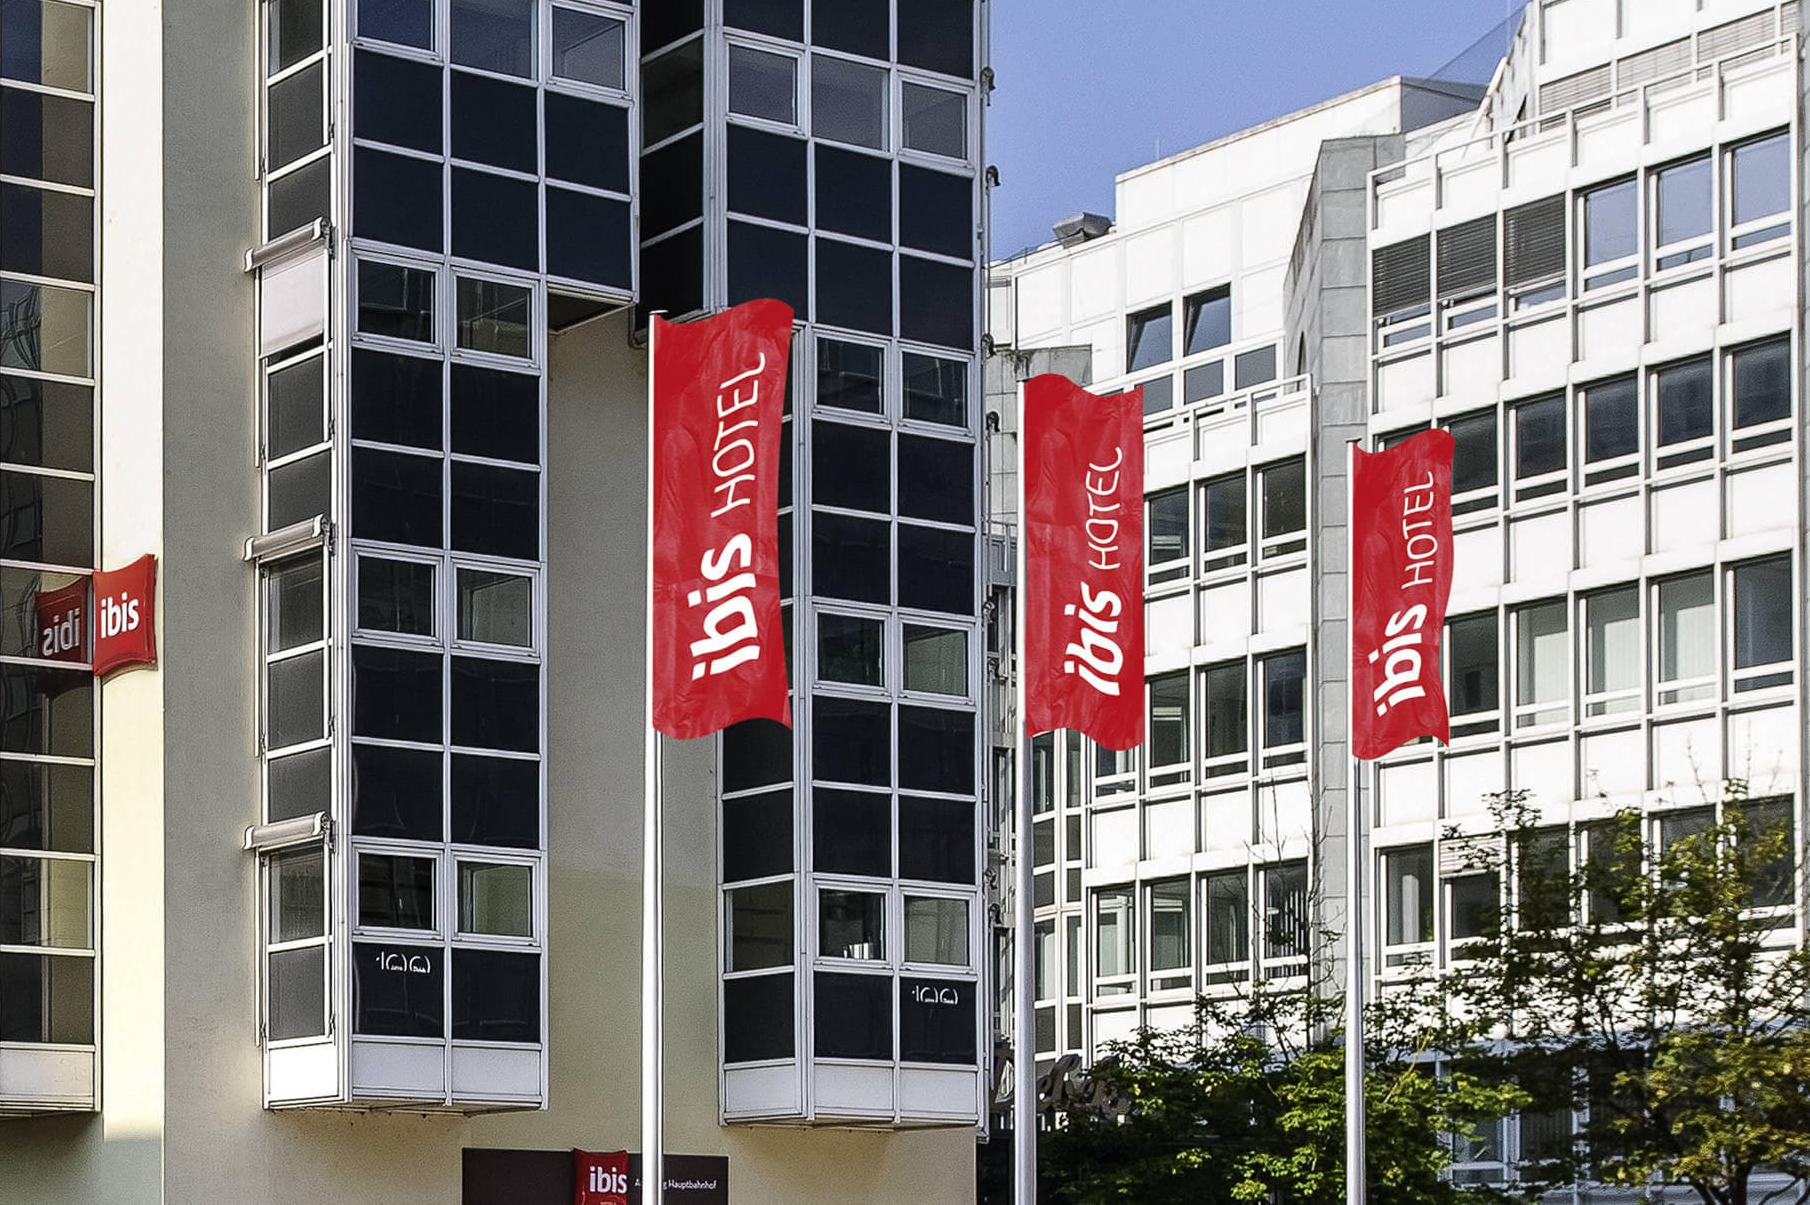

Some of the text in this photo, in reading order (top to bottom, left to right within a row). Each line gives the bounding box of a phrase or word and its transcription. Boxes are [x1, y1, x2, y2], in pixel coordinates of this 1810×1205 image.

[687, 352, 766, 681] ibis HOTEL
[1063, 446, 1124, 696] ibis HOTEL
[100, 591, 140, 639] ibis
[1367, 471, 1438, 717] ibis HOTEL
[589, 1165, 628, 1194] ibis
[668, 1179, 717, 1190] Hauptbahnhof
